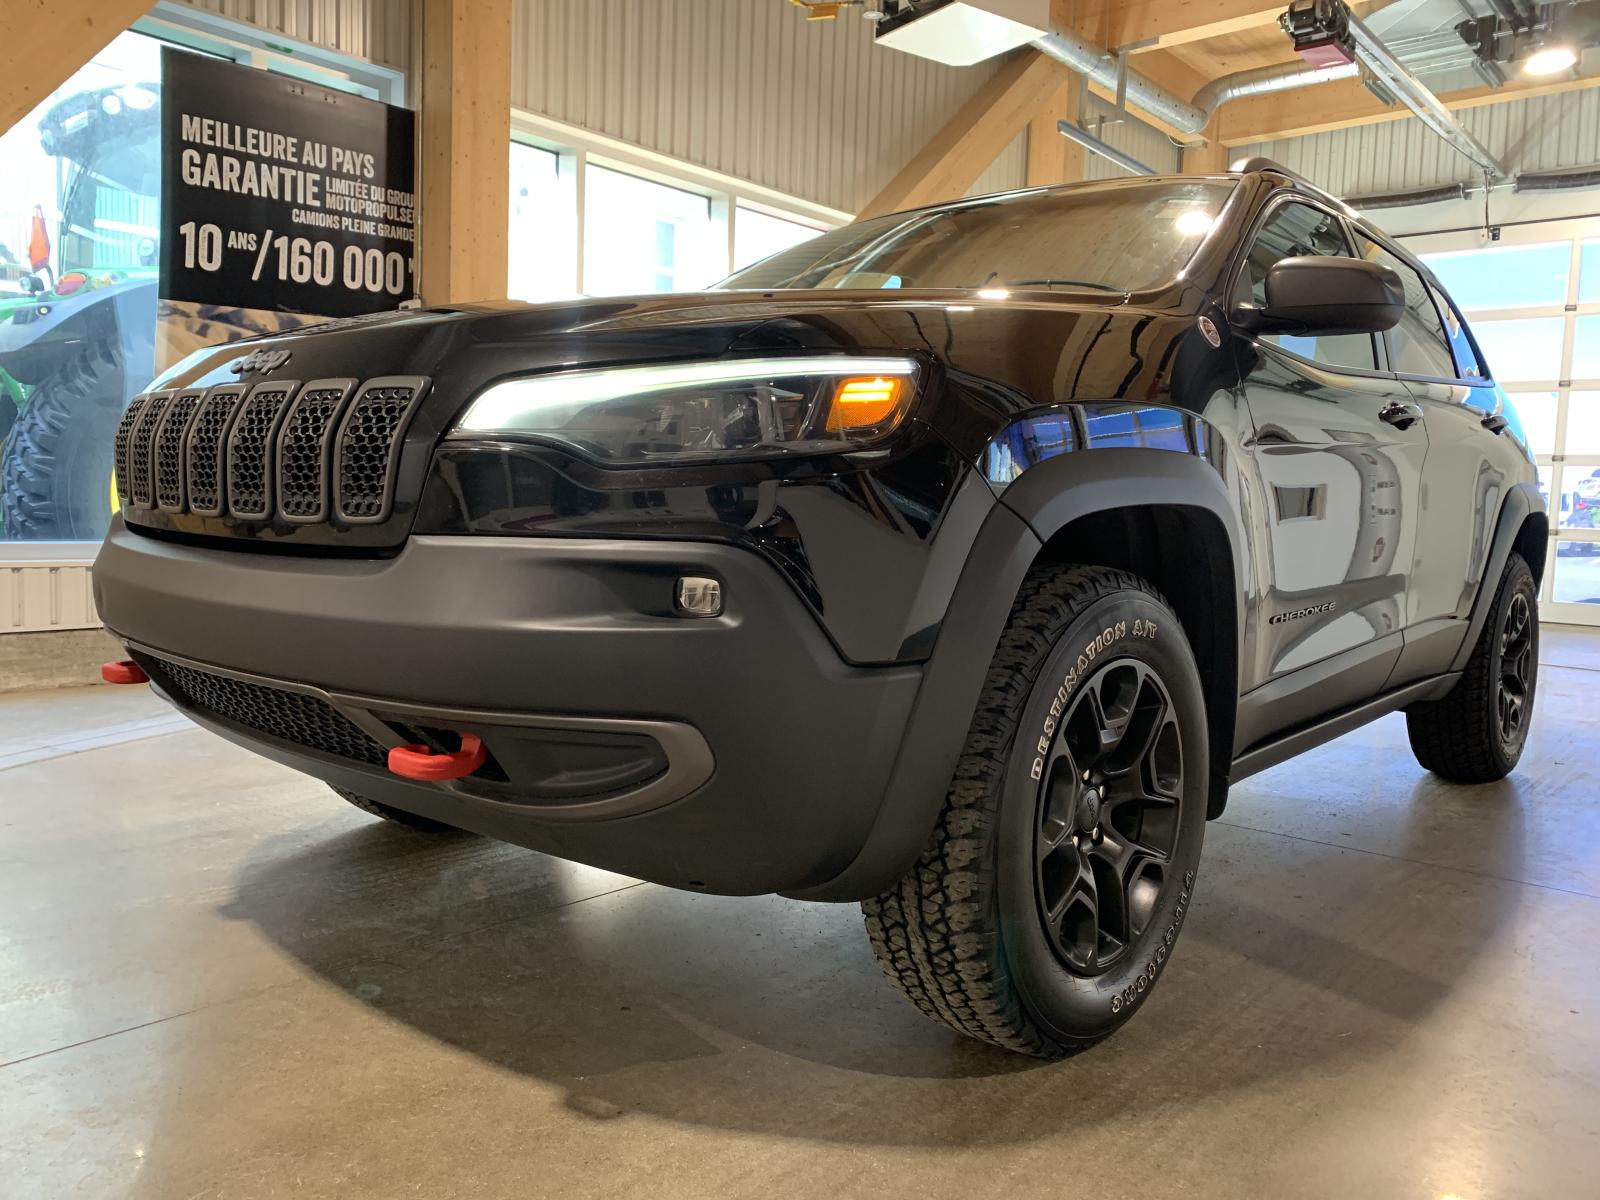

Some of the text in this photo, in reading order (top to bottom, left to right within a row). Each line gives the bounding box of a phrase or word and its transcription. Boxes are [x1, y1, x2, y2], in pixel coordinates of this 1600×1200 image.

[181, 113, 375, 178] MEILLEURE AU PAYS
[181, 148, 320, 207] GARANTIE
[325, 176, 369, 199] LIMITÉE
[370, 185, 385, 202] DU
[292, 208, 340, 230] CAMIONS
[341, 217, 377, 236] PLEINE
[325, 192, 414, 224] MOTOPROPULSE
[179, 221, 222, 271] 10
[227, 230, 257, 251] ANS
[343, 245, 404, 295] 000
[230, 349, 292, 375] Jeep
[1269, 602, 1336, 625] CHEROKEE
[1030, 619, 1157, 780] DESTINATION A/T
